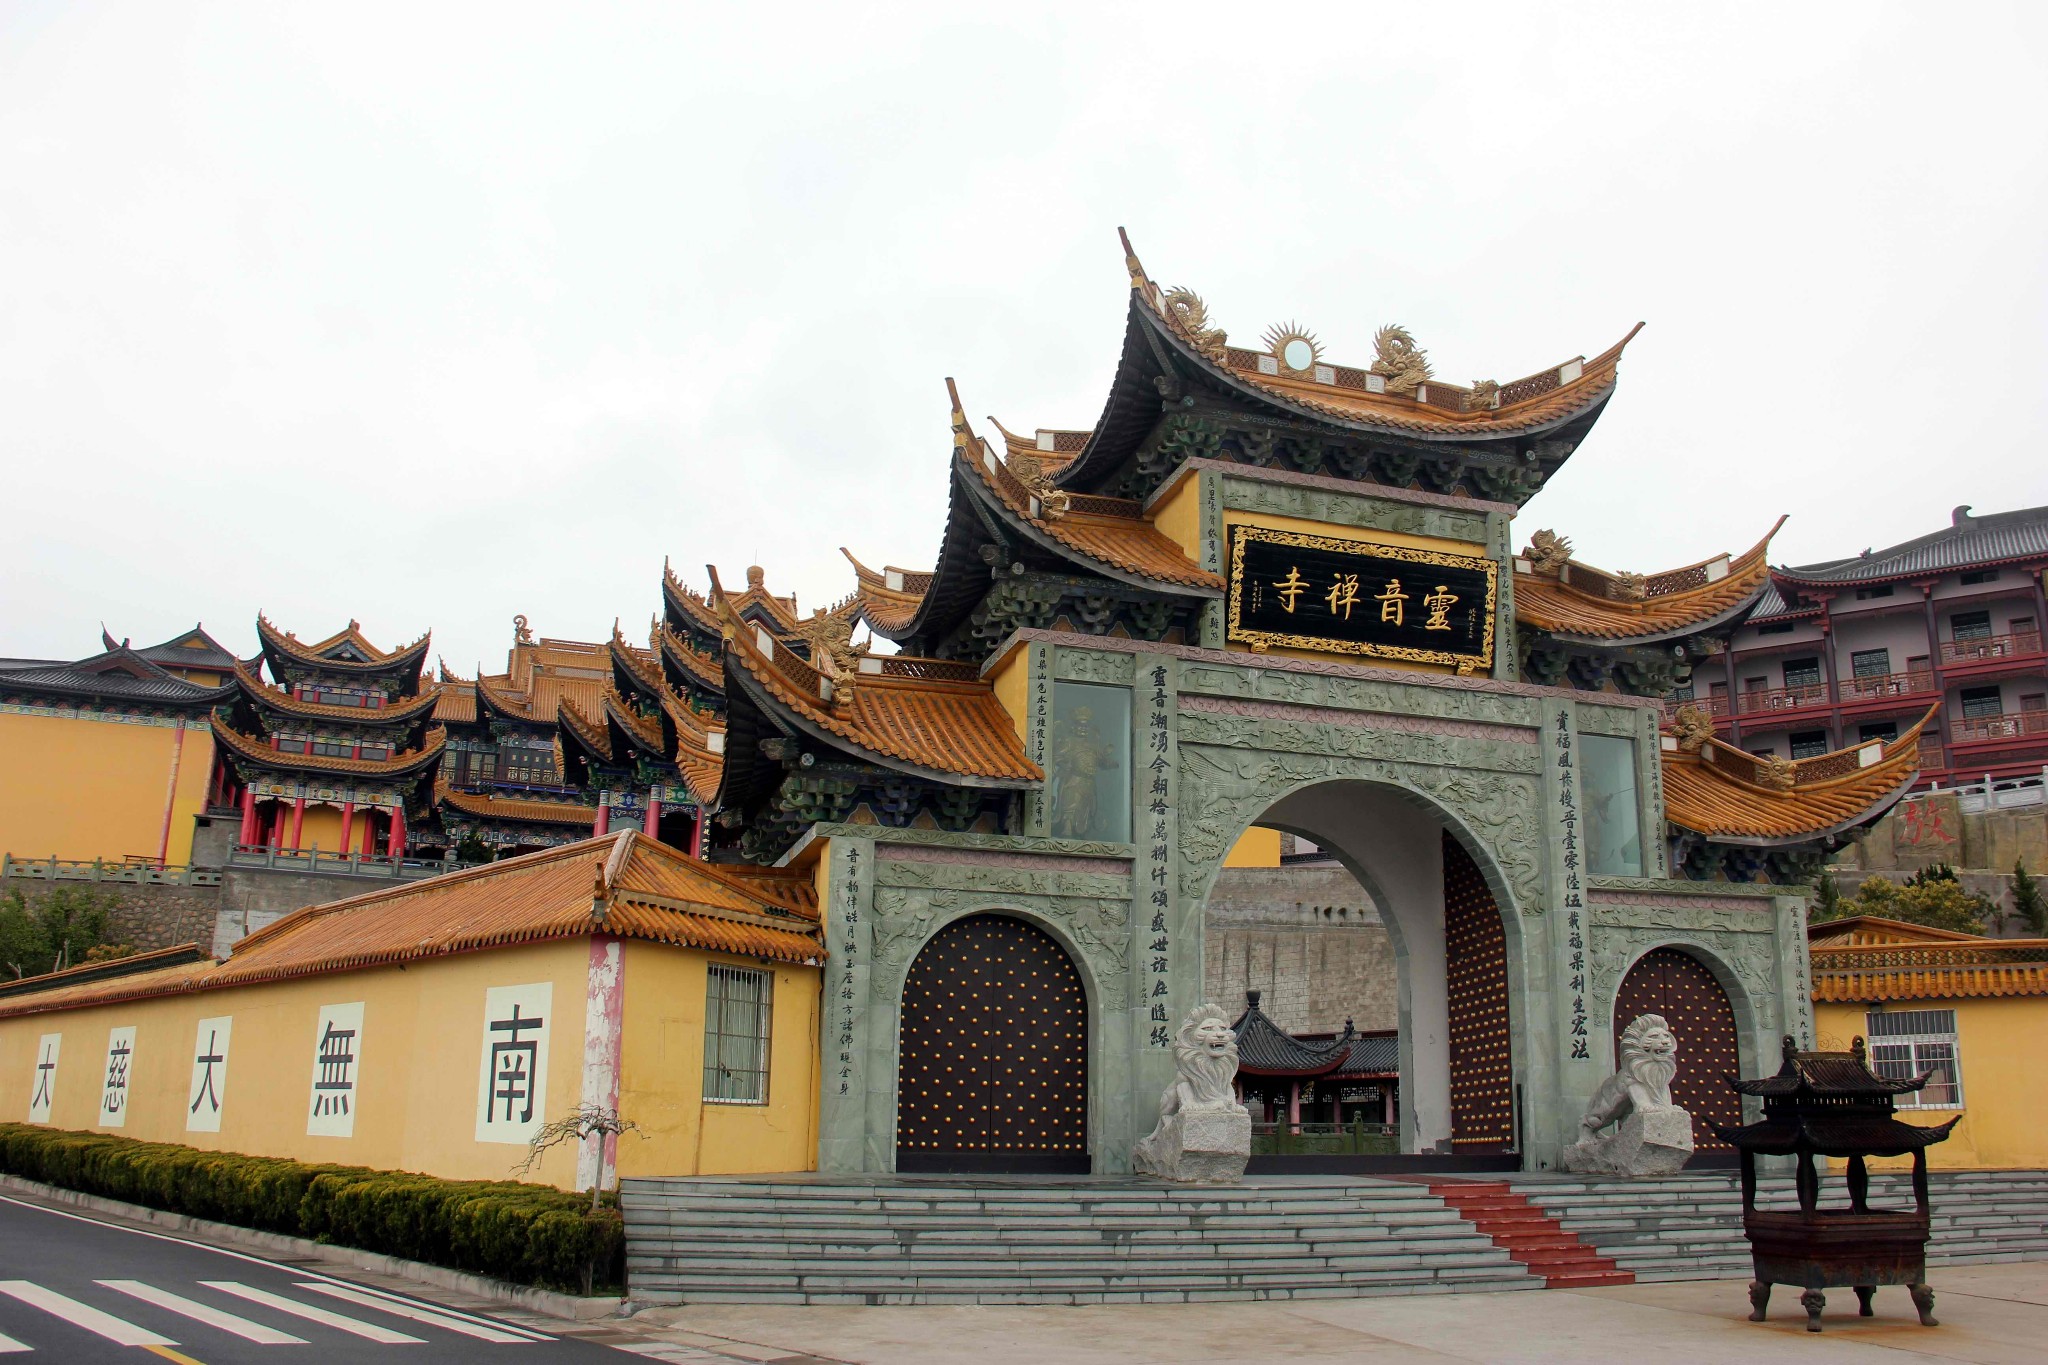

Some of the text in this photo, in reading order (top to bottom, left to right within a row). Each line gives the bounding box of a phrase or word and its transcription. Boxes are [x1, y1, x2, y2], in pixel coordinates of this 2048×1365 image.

[1899, 799, 1957, 845] 放
[32, 1004, 543, 1124] 南 無 大 慈 大
